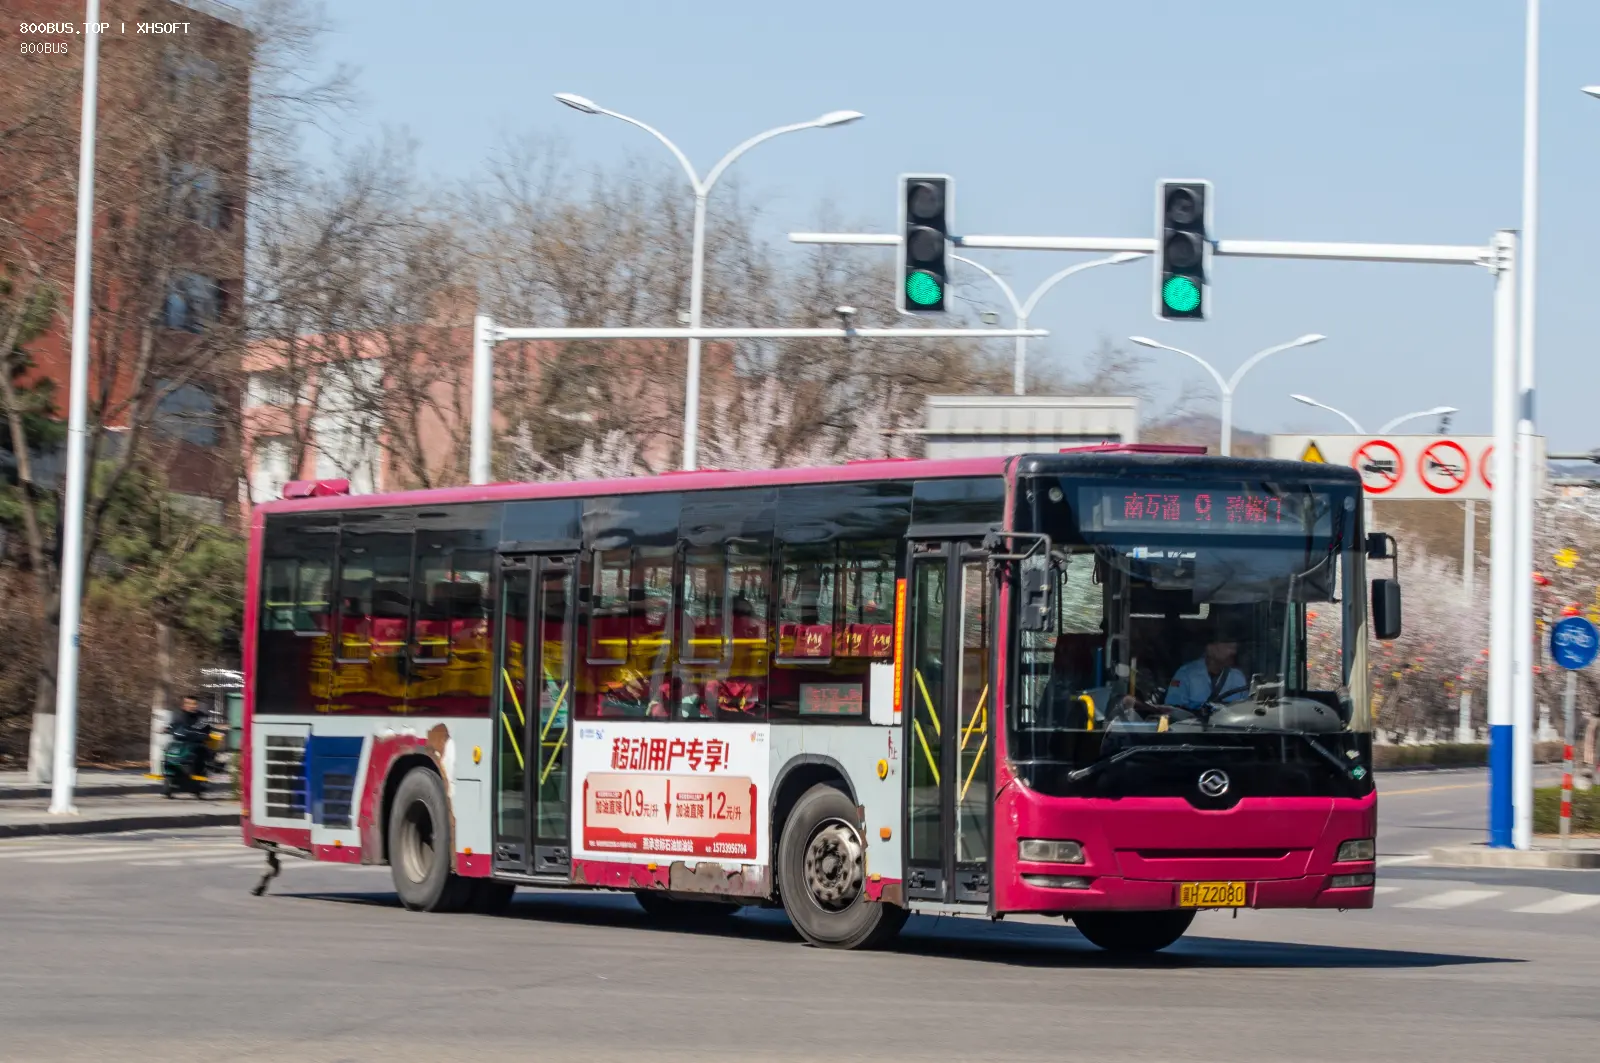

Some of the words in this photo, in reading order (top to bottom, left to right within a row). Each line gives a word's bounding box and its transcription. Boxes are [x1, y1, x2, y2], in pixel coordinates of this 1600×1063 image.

[611, 736, 730, 773] 移动用户专享!
